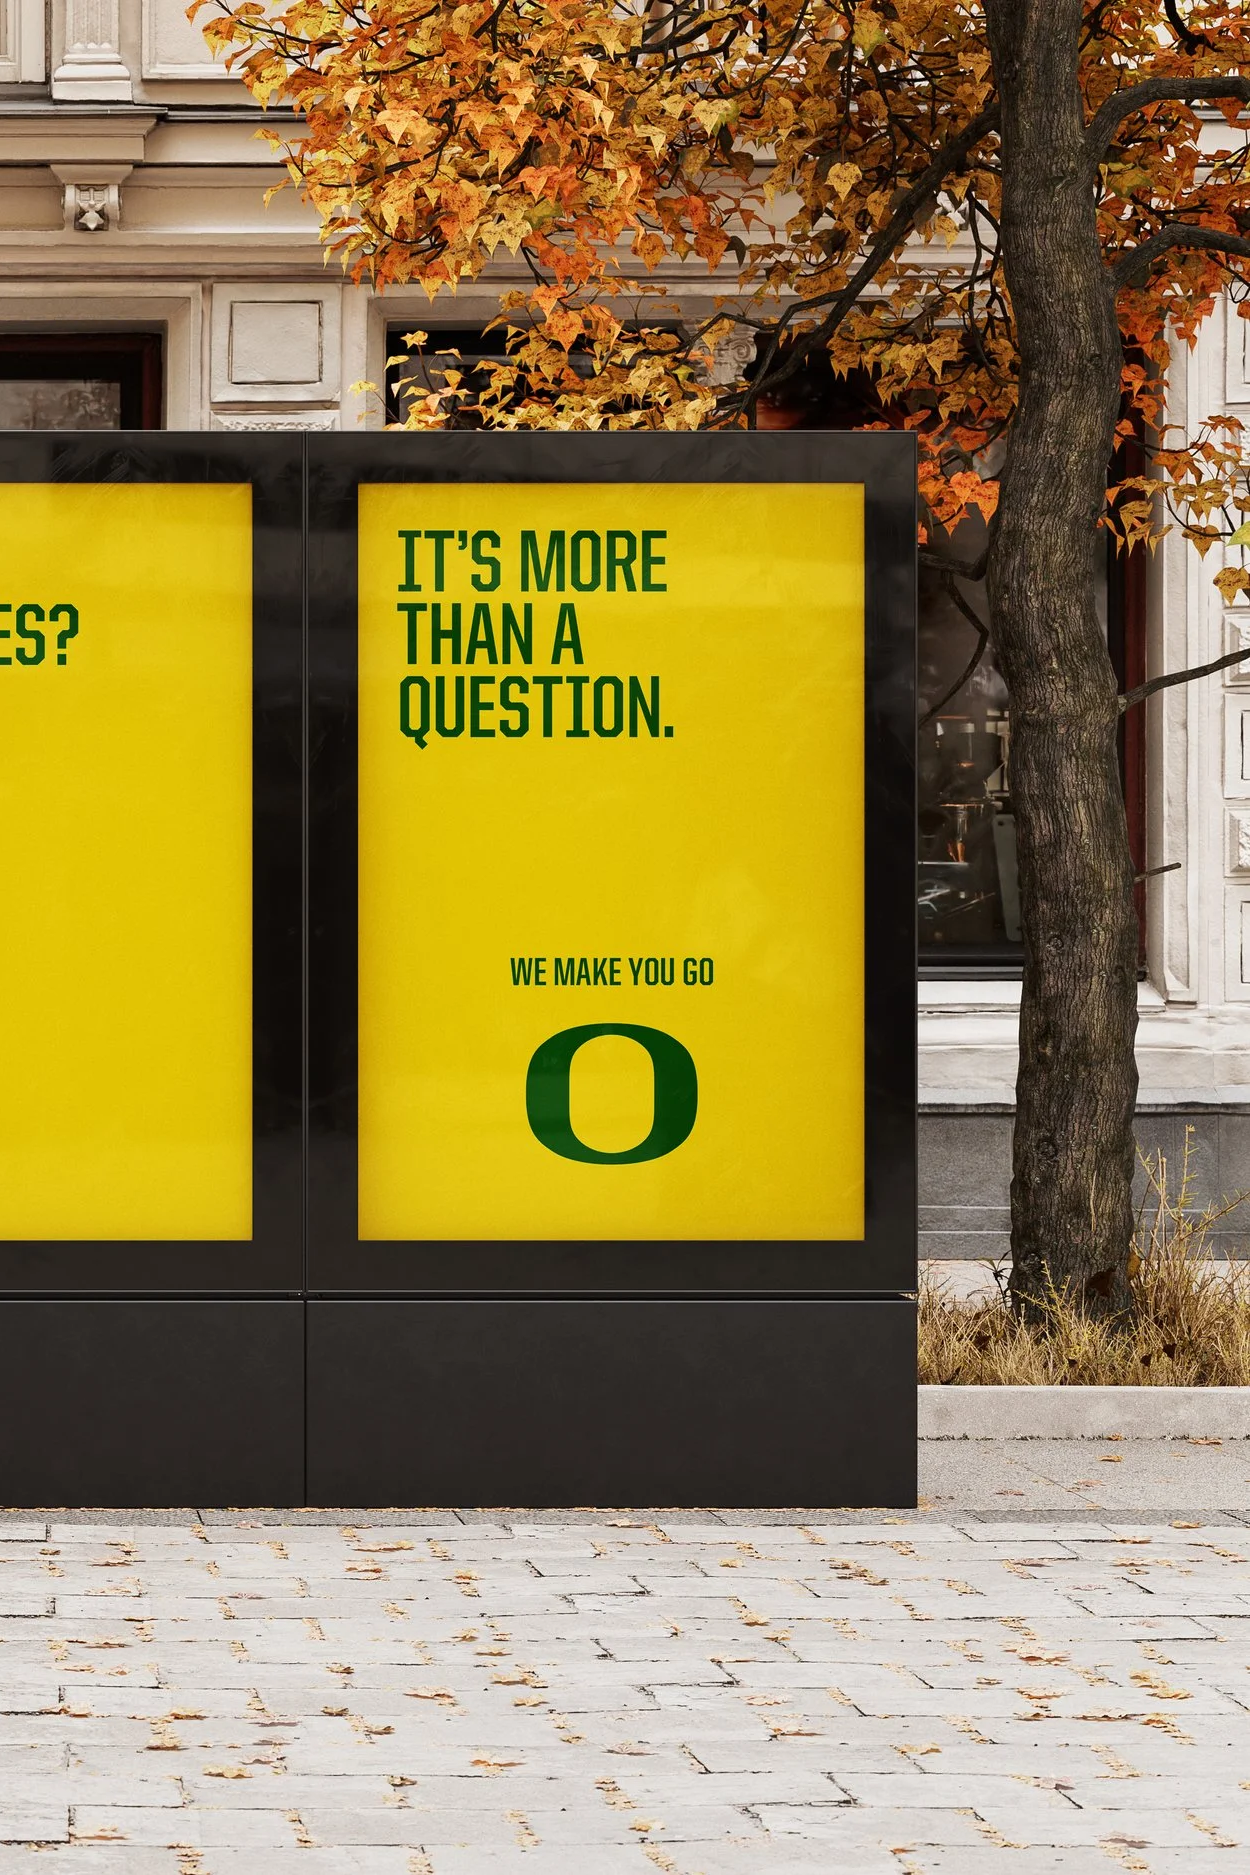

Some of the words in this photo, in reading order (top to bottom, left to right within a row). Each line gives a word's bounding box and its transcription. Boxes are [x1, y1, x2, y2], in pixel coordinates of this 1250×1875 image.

[397, 529, 501, 593] IT’S
[520, 529, 668, 593] MORE
[396, 602, 533, 665] THAN
[550, 602, 585, 665] A
[398, 675, 675, 750] QUESTION.
[510, 957, 547, 986] WE
[554, 957, 622, 986] MAKE
[629, 957, 675, 986] YOU
[683, 957, 714, 986] GO
[525, 1022, 699, 1166] O
